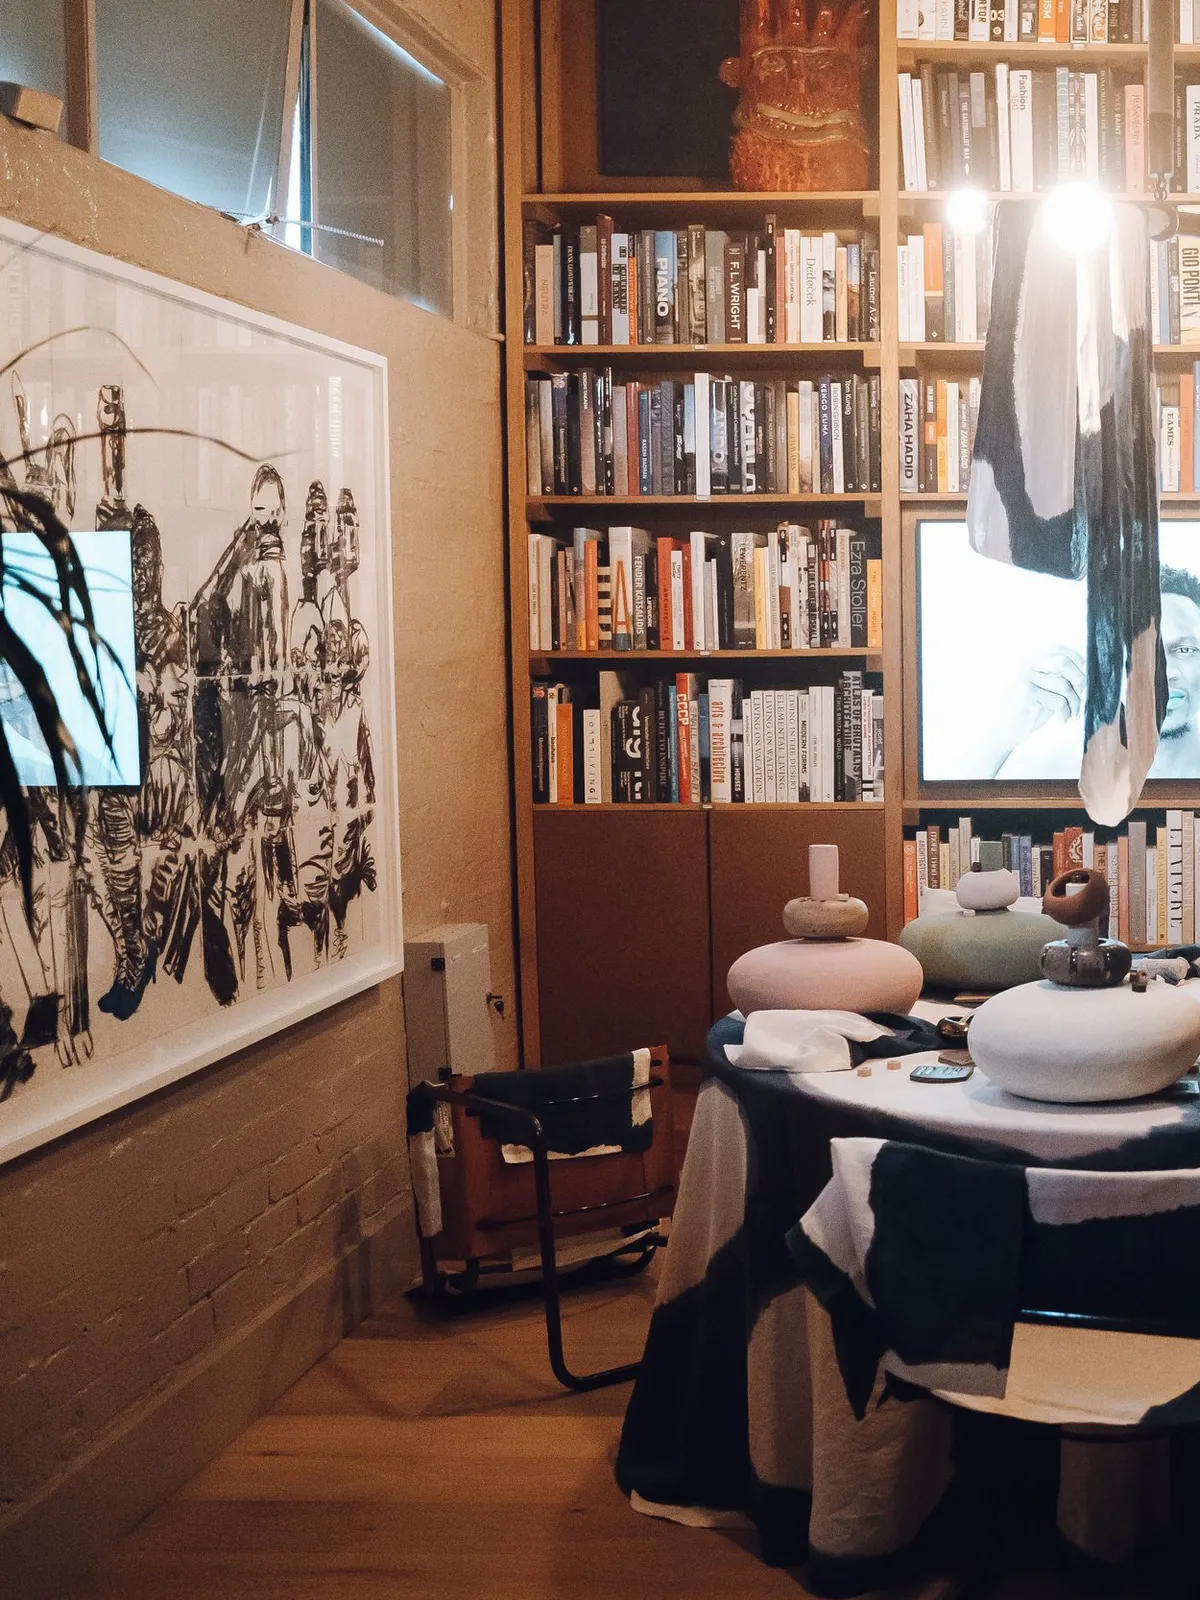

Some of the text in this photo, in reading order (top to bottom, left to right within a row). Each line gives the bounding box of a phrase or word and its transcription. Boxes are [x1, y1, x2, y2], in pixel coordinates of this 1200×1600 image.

[1019, 74, 1029, 110] Fashion
[1193, 101, 1200, 140] PRADA
[541, 278, 549, 317] NEUTRA
[656, 257, 669, 317] PIANO
[1182, 248, 1200, 306] GIO PONTI
[844, 394, 852, 415] Kundig
[904, 392, 914, 468] ZAHA HADID
[1166, 413, 1174, 447] EAMES
[634, 556, 645, 635] FENDER KATSALIDIS
[739, 542, 748, 591] LEWERENTZ
[850, 541, 867, 630] Ezra Stoller
[677, 694, 689, 726] CCCP
[765, 694, 775, 782] LIVING ON WATER
[842, 675, 852, 751] ARCHITECTURE
[852, 675, 861, 779] ATLAS OF BRUTALIST
[659, 737, 667, 750] TO
[659, 752, 668, 787] INSPIRE
[690, 706, 700, 796] SMALL SMART
[711, 701, 726, 784] arts architecture
[753, 697, 763, 794] LIVING ON VACATION
[776, 694, 786, 790] ELEMENTAL LIVING
[788, 694, 797, 792] LIVING IN THE DESERT
[734, 768, 742, 792] HOUSES
[1098, 852, 1106, 868] THE
[1158, 863, 1166, 896] AARONS
